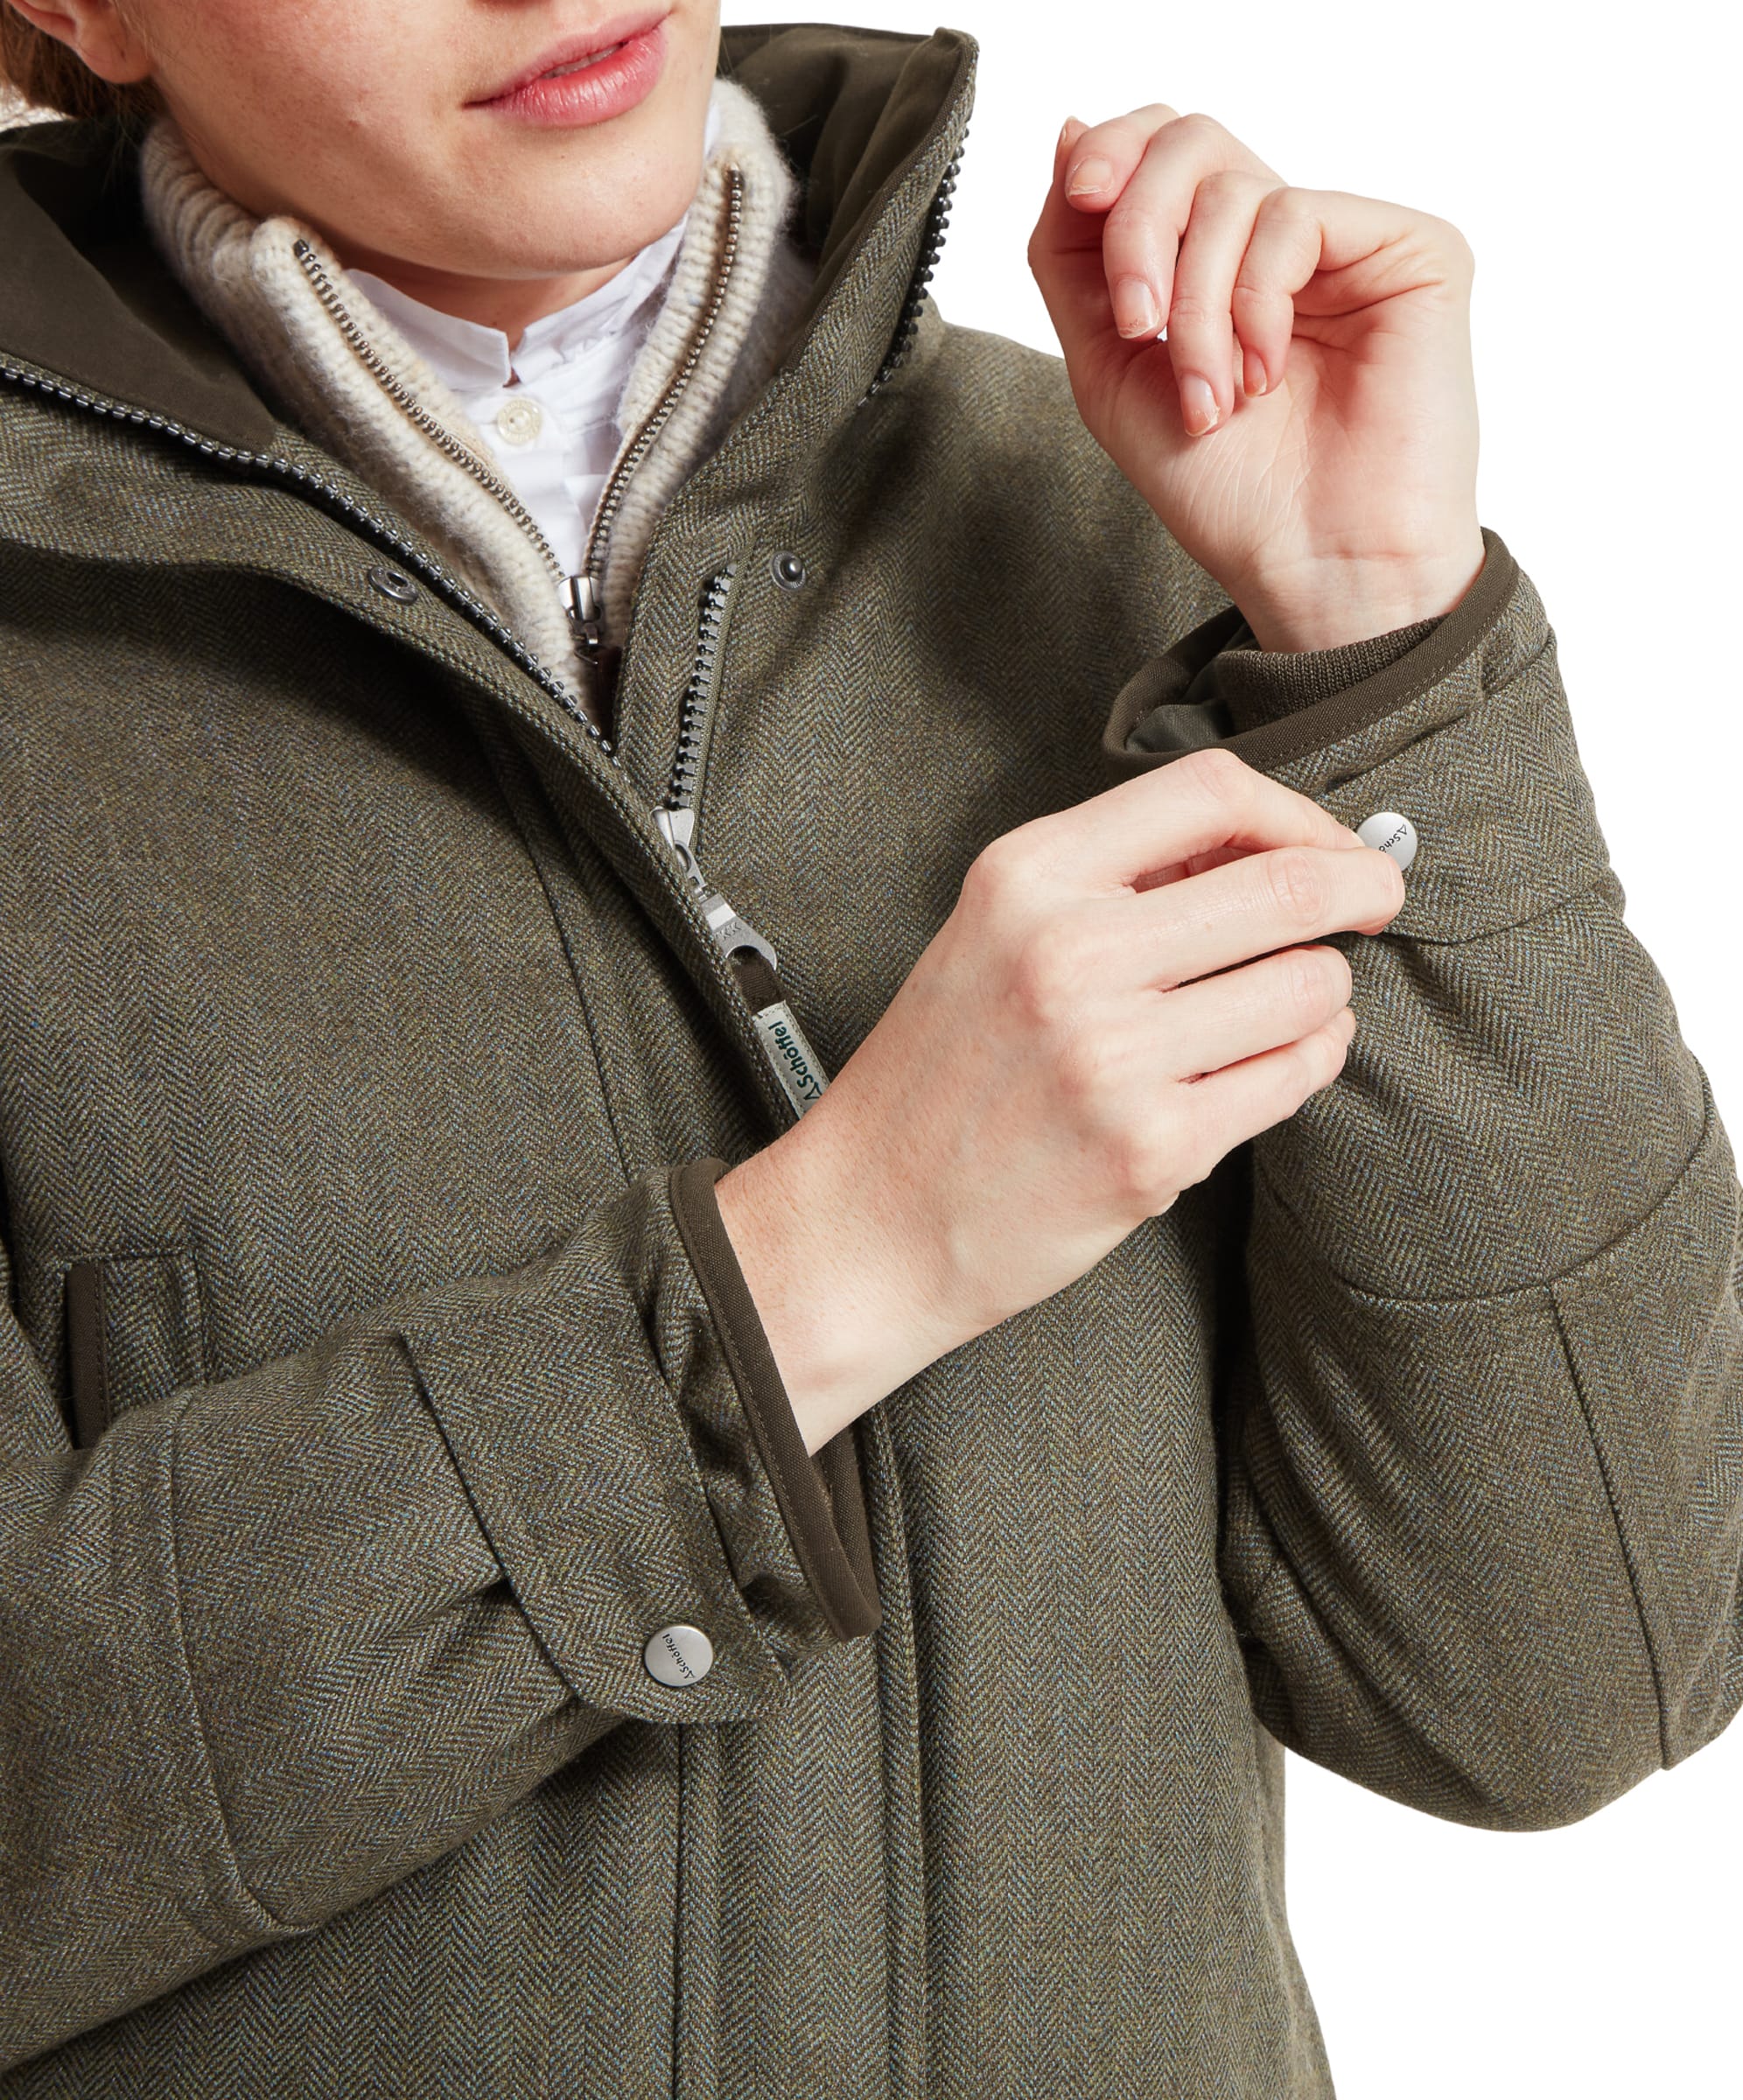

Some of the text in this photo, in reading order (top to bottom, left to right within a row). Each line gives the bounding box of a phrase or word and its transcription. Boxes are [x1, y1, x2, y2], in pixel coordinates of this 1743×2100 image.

[1378, 833, 1401, 853] Schö
[768, 1021, 814, 1088] Schöffel
[662, 1634, 690, 1673] Schöffel
